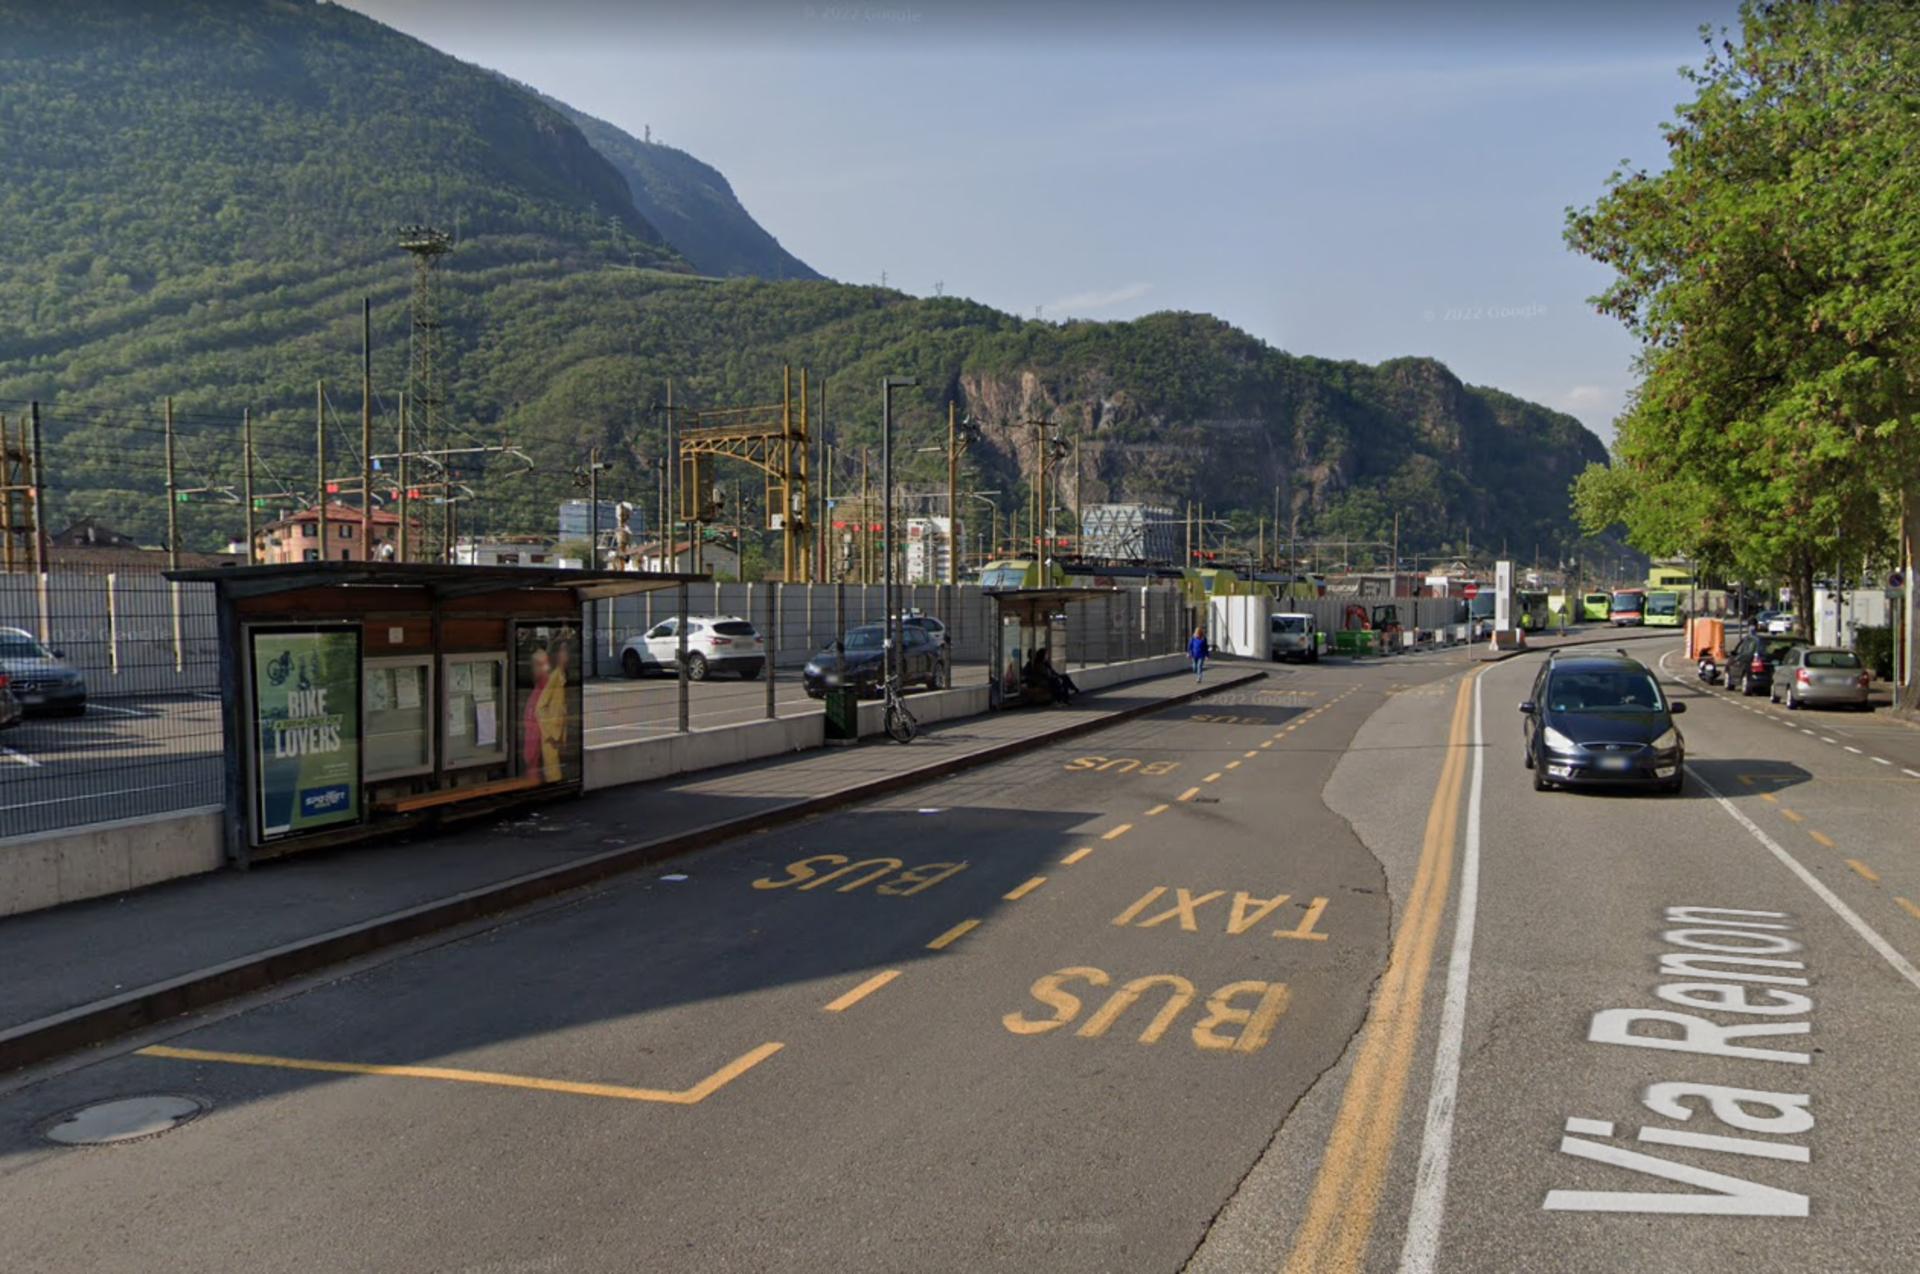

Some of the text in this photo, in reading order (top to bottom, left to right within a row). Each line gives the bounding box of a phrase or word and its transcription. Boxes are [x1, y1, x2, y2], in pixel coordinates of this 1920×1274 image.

[288, 688, 328, 718] BIKE
[275, 725, 342, 759] LOVERS
[1063, 755, 1181, 776] BUS
[751, 853, 971, 897] BUS
[1112, 886, 1330, 942] TAXI
[1003, 965, 1292, 1052] BUS
